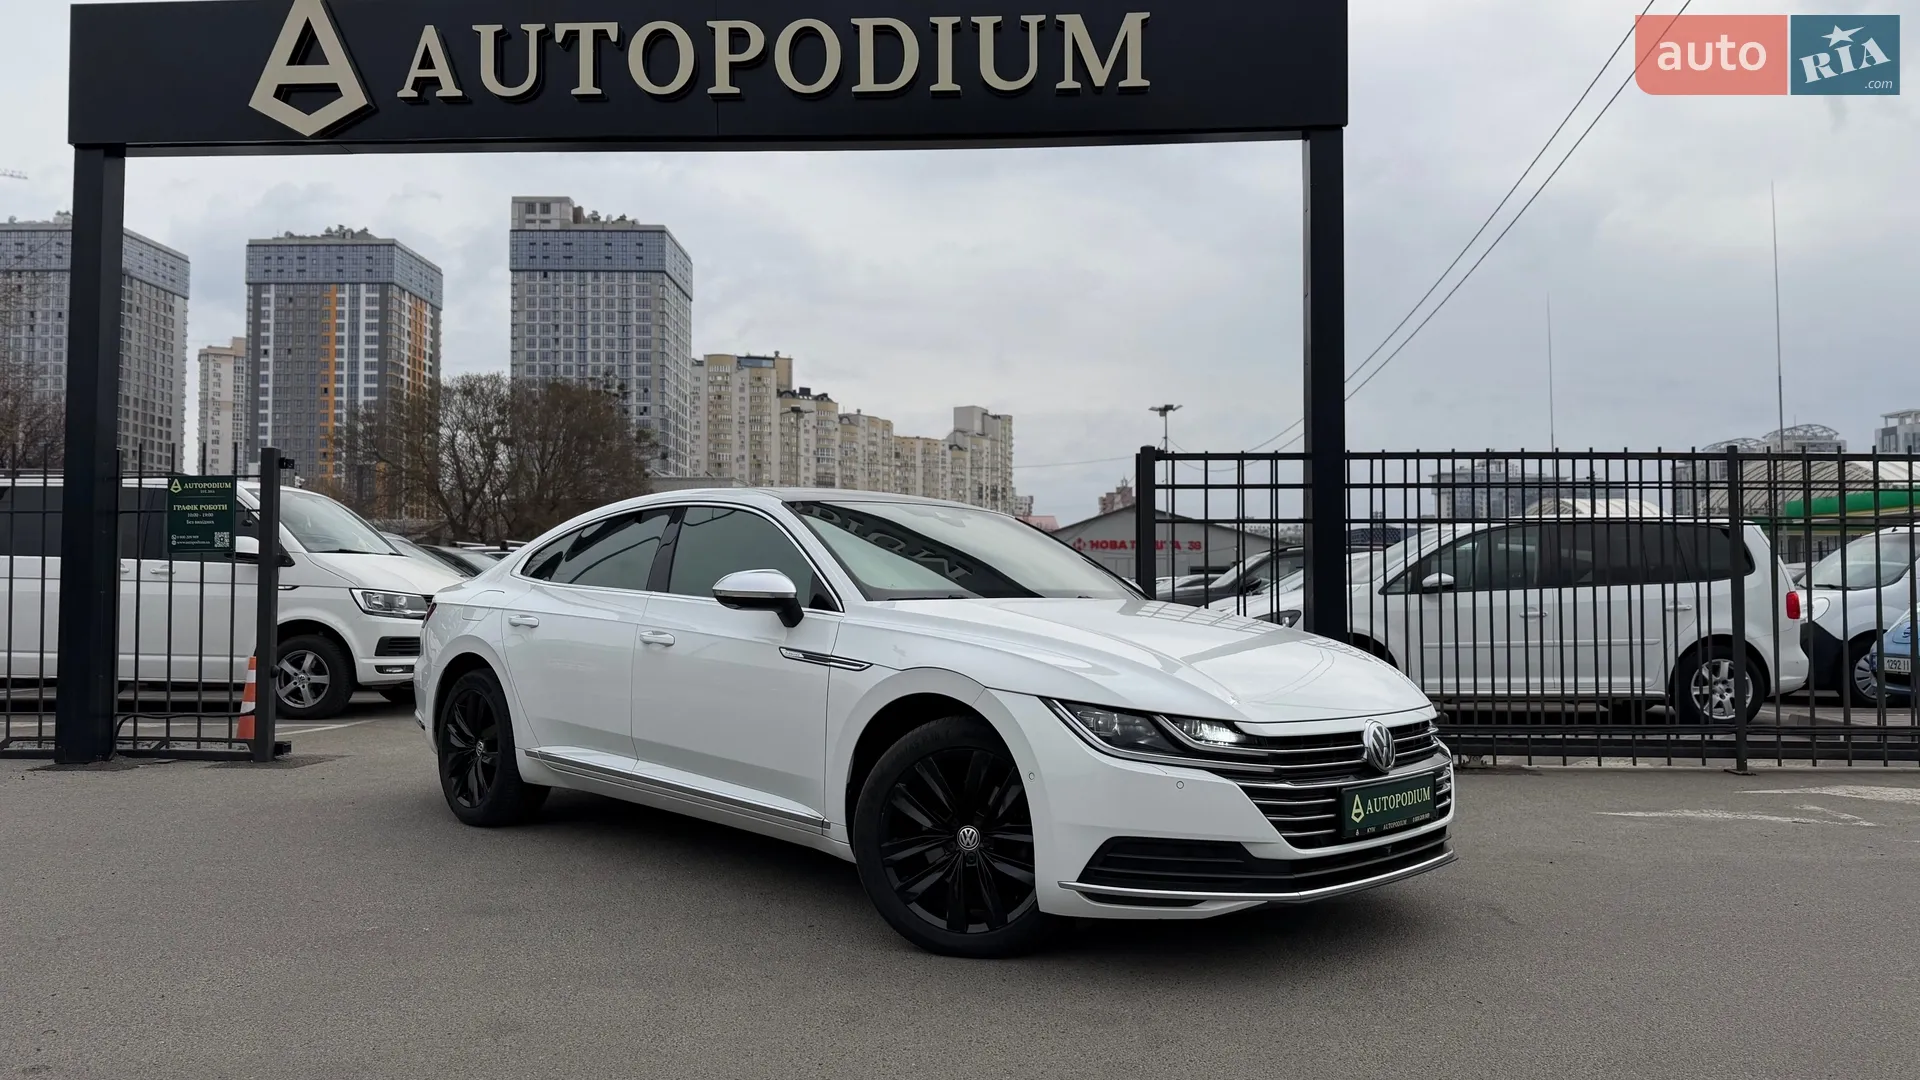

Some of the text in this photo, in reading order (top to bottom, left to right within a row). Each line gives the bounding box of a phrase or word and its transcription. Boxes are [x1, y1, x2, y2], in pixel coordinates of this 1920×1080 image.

[396, 12, 1151, 99] AUTOPODIUM
[1089, 540, 1127, 550] НОВА
[1366, 786, 1431, 815] AUTOPODIUM
